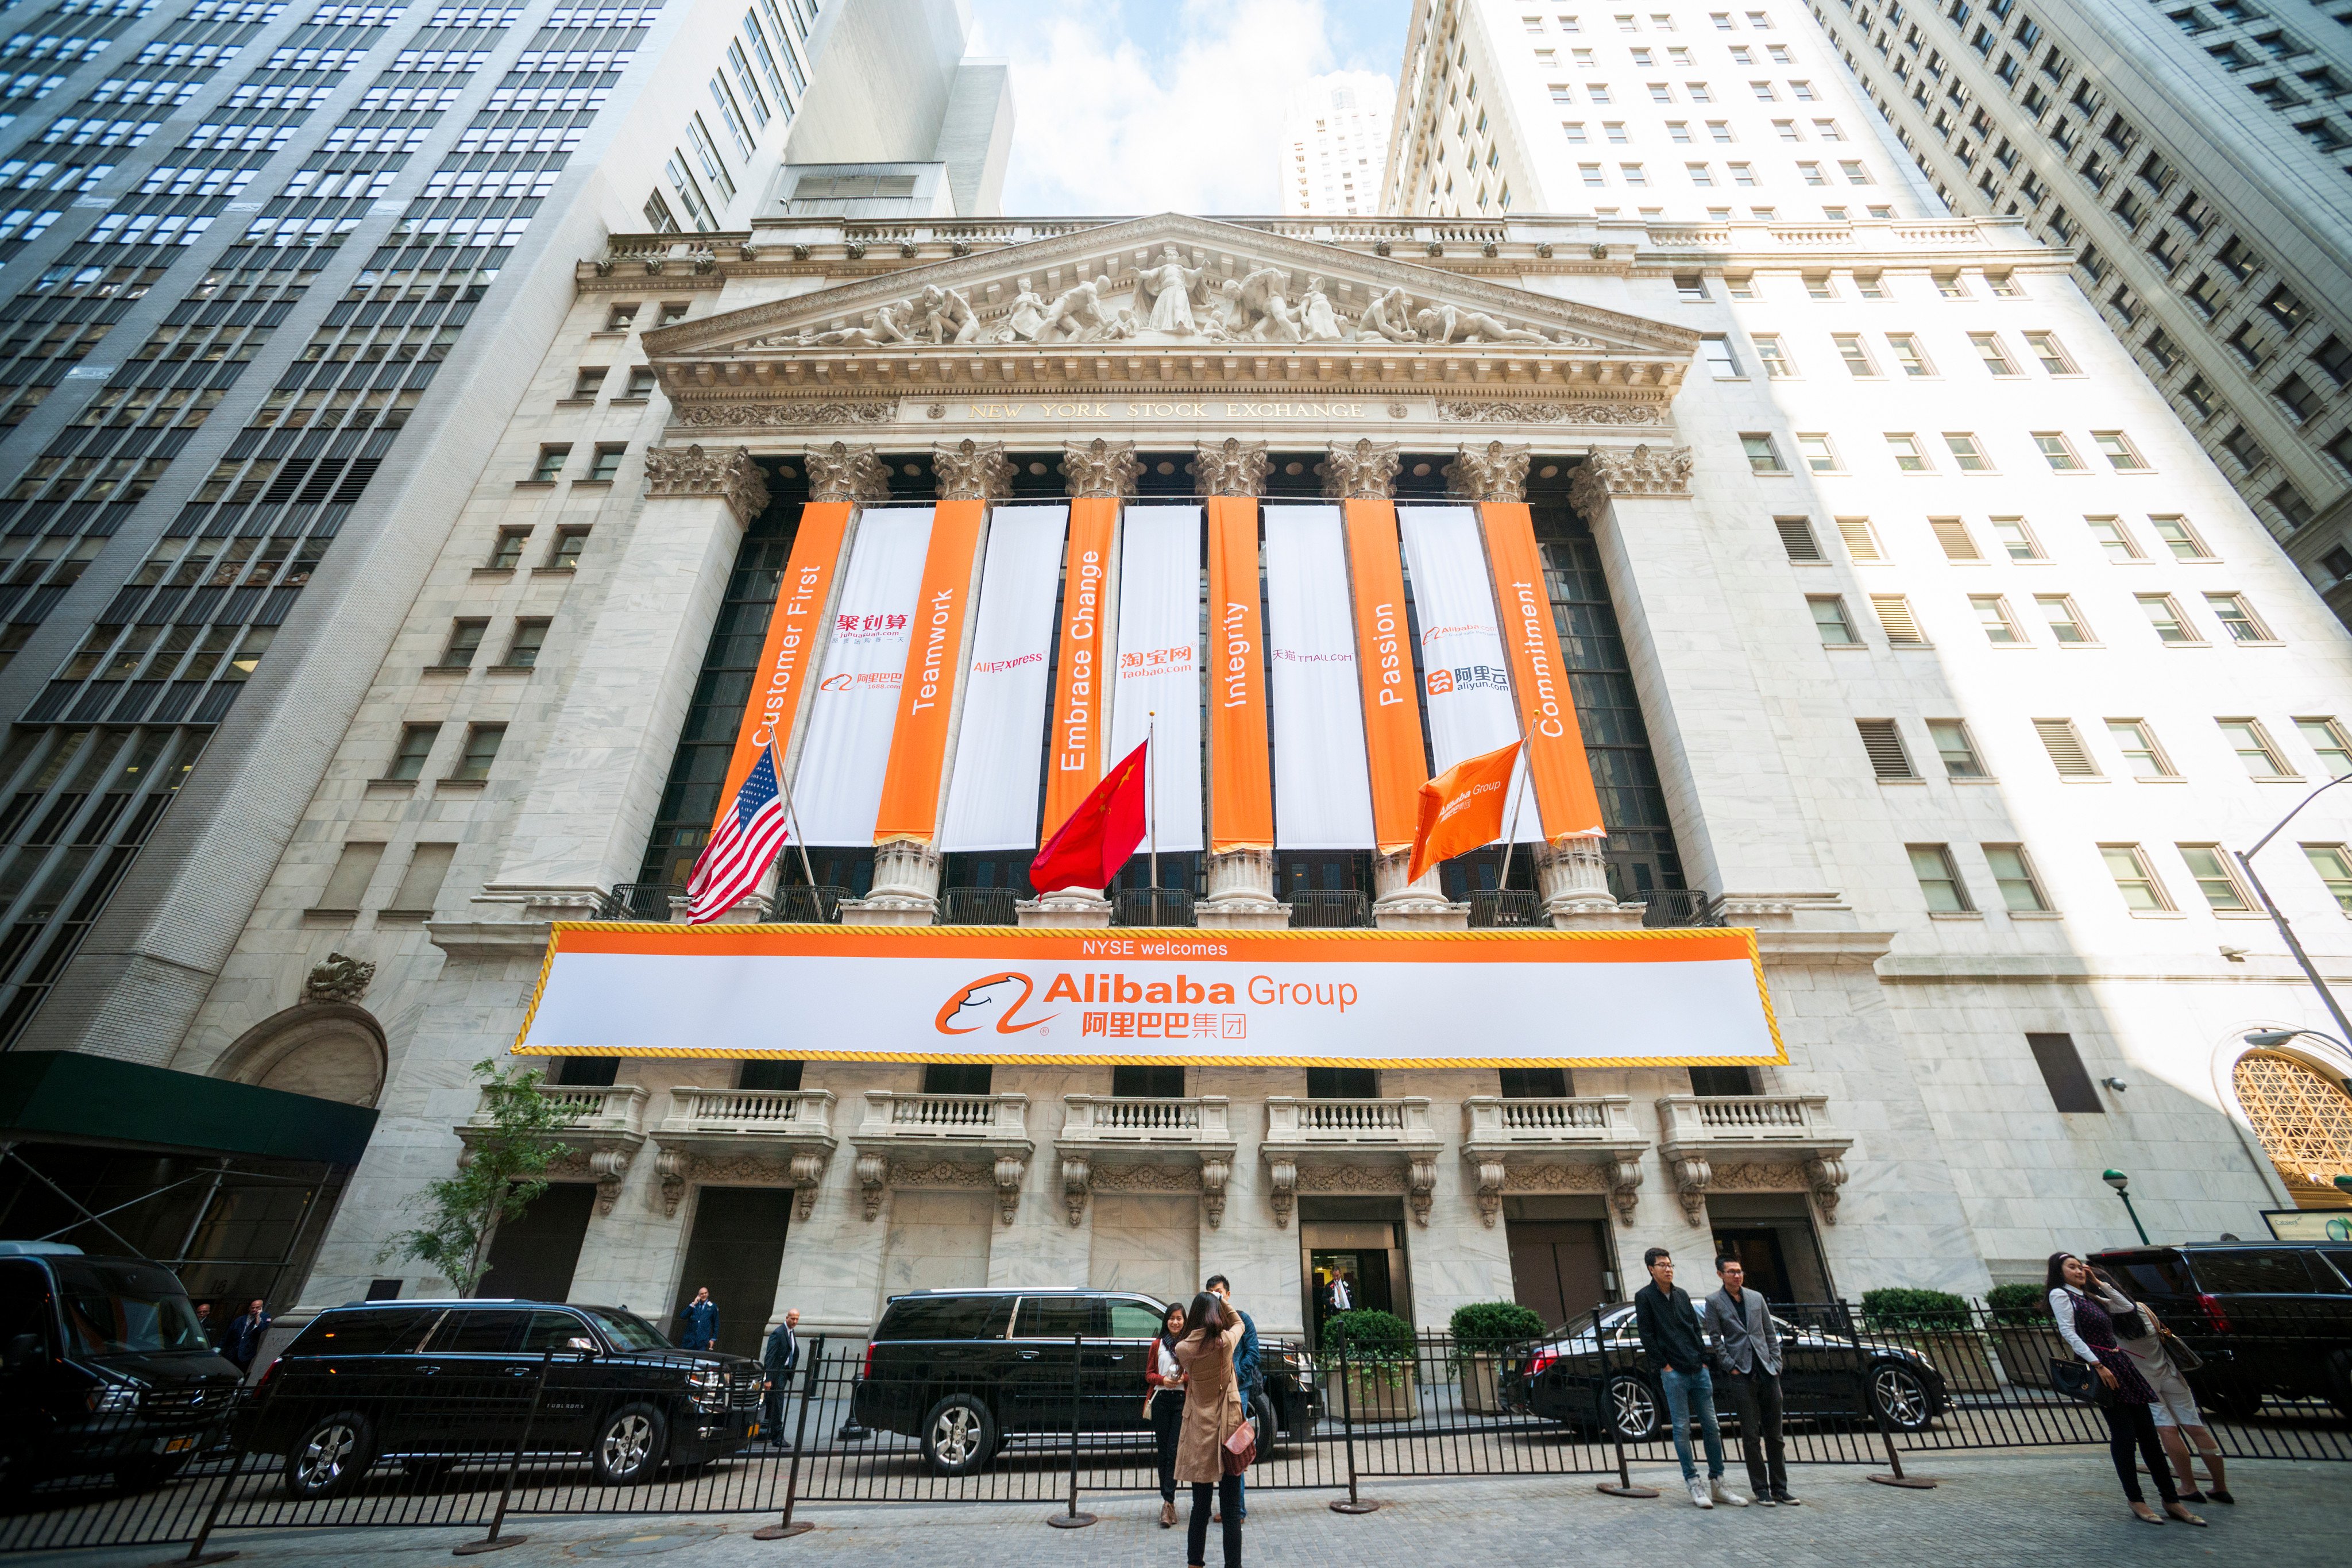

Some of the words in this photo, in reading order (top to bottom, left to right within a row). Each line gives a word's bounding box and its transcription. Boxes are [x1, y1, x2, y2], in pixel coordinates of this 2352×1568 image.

[968, 404, 1025, 419] NEW
[1040, 404, 1111, 418] YORK
[1126, 403, 1209, 418] STOCK
[1225, 403, 1366, 418] EXCHANGE
[1071, 551, 1102, 640] Change
[836, 614, 909, 632] 聚划算
[752, 624, 803, 747] Customer
[787, 566, 821, 616] First
[912, 588, 953, 716] Teamwork
[1121, 646, 1192, 669] 淘宝网
[1223, 603, 1250, 708] Integrity
[1272, 649, 1296, 661] 天猫
[1373, 604, 1403, 706] Passion
[1512, 581, 1563, 737] Commitment
[856, 673, 902, 684] 阿里巴巴
[1122, 665, 1192, 679] Taobao.com
[1454, 665, 1507, 685] 阿里云
[1457, 681, 1509, 692] aliyun.com
[1061, 650, 1091, 771] Embrace
[1473, 781, 1501, 795] Group
[1083, 941, 1134, 955] NYSE
[1140, 941, 1228, 956] welcomes
[1042, 973, 1235, 1004] Alibaba
[1248, 975, 1358, 1013] Group
[1082, 1011, 1246, 1039] 阿里巴巴集团
